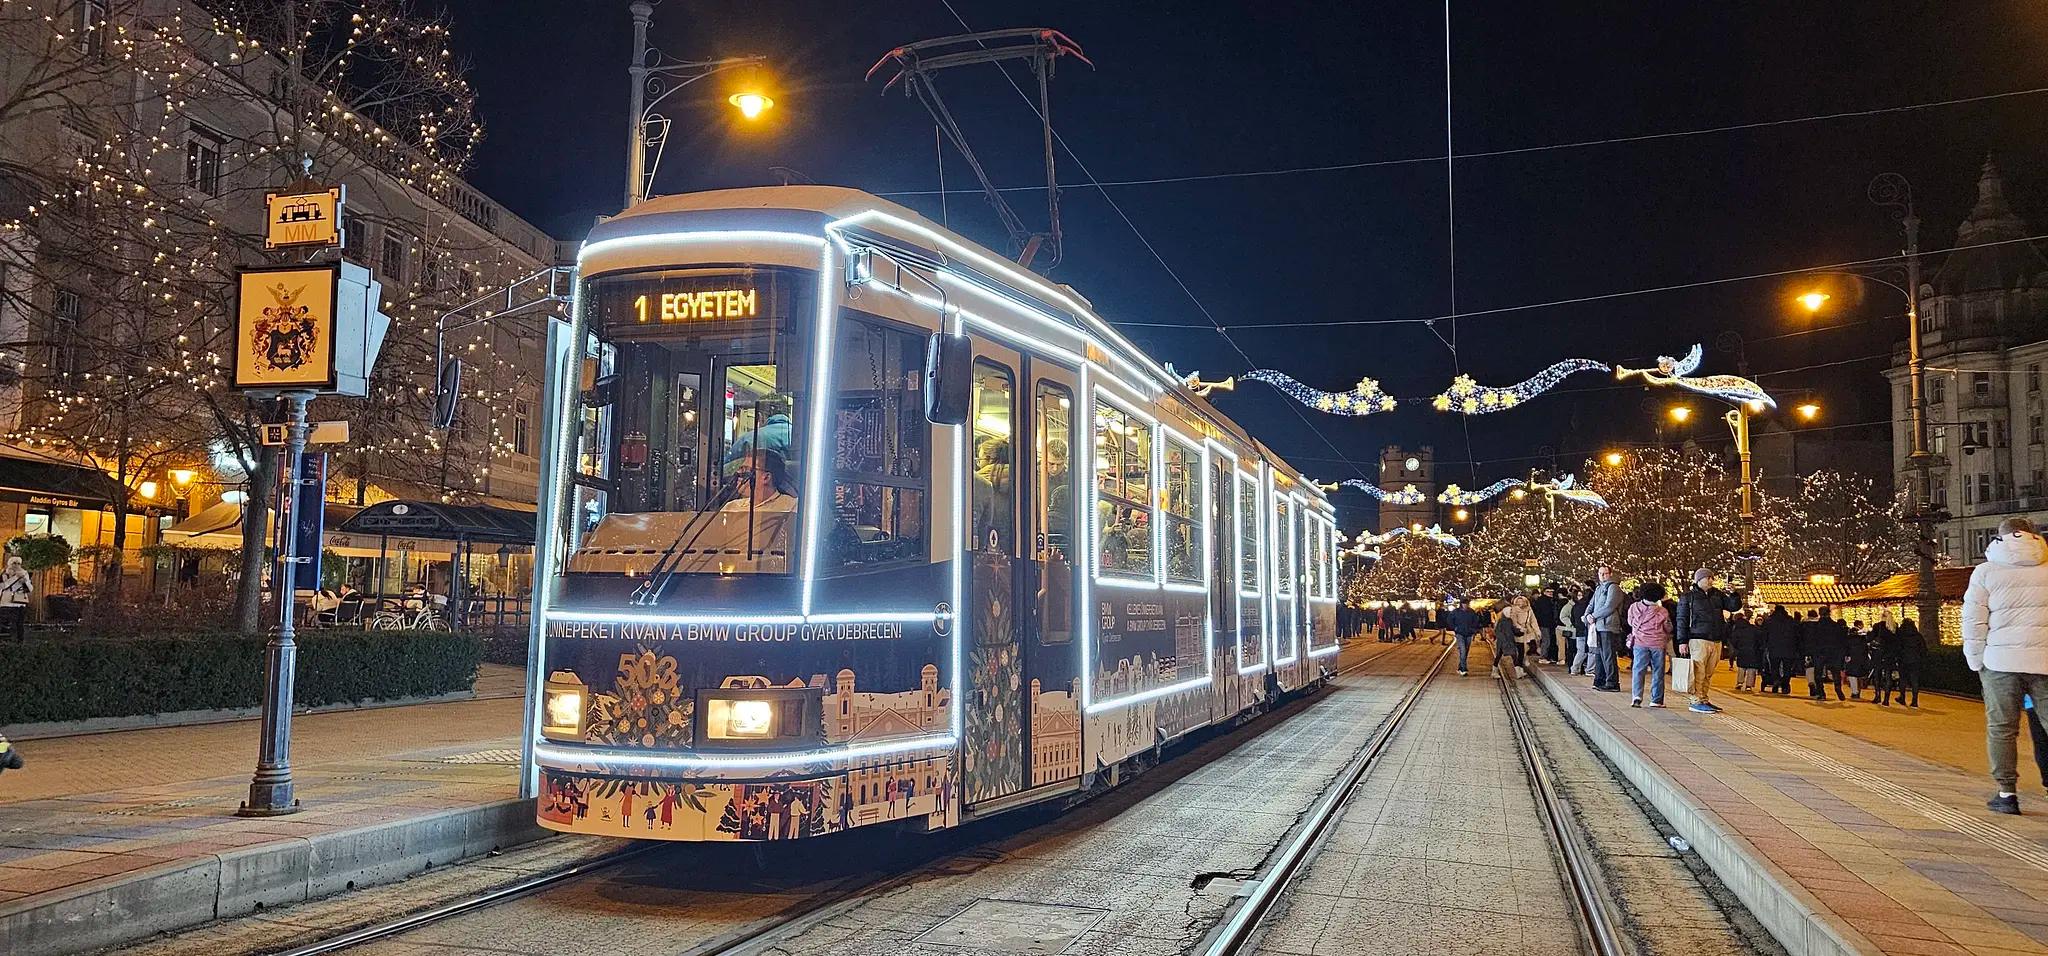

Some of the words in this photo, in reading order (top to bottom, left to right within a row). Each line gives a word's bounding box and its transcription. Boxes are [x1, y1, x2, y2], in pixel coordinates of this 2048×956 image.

[285, 223, 317, 242] MM
[634, 294, 647, 322] 1
[661, 288, 756, 320] EGYETEM
[671, 623, 683, 641] A
[687, 623, 731, 642] BMW
[735, 624, 797, 642] GROUP
[837, 622, 902, 641] DEBRECEN!
